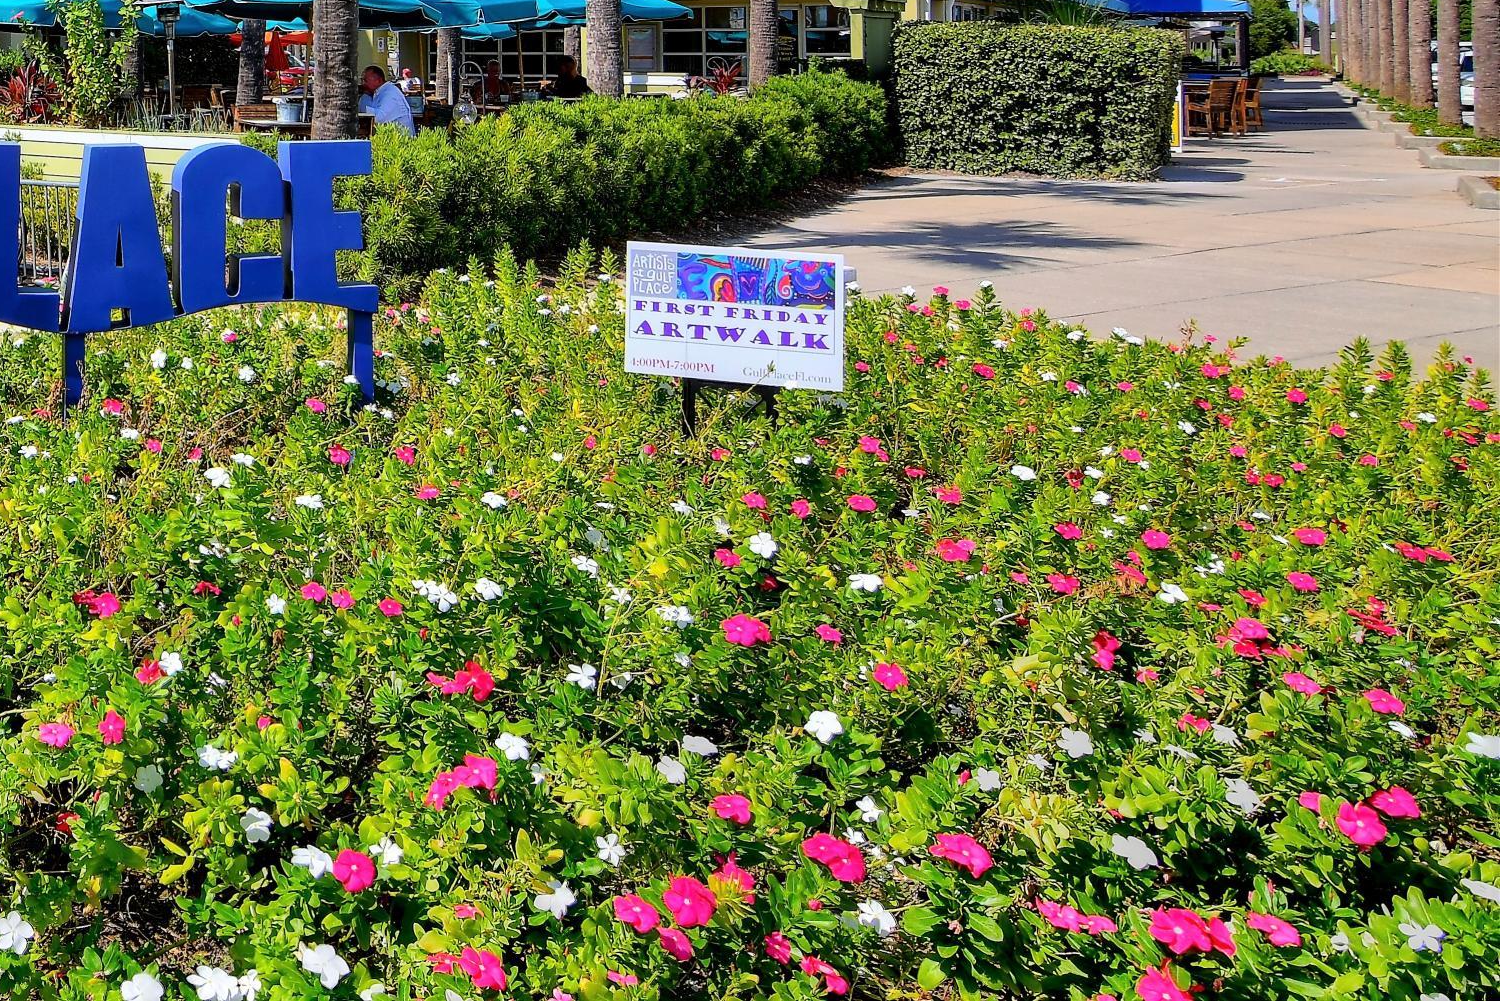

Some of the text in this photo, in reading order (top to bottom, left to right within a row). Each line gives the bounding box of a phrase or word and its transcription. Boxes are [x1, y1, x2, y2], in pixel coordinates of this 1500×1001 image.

[632, 269, 644, 278] at
[632, 300, 829, 326] FIRST FRIDAY
[632, 319, 831, 350] ARTWALK
